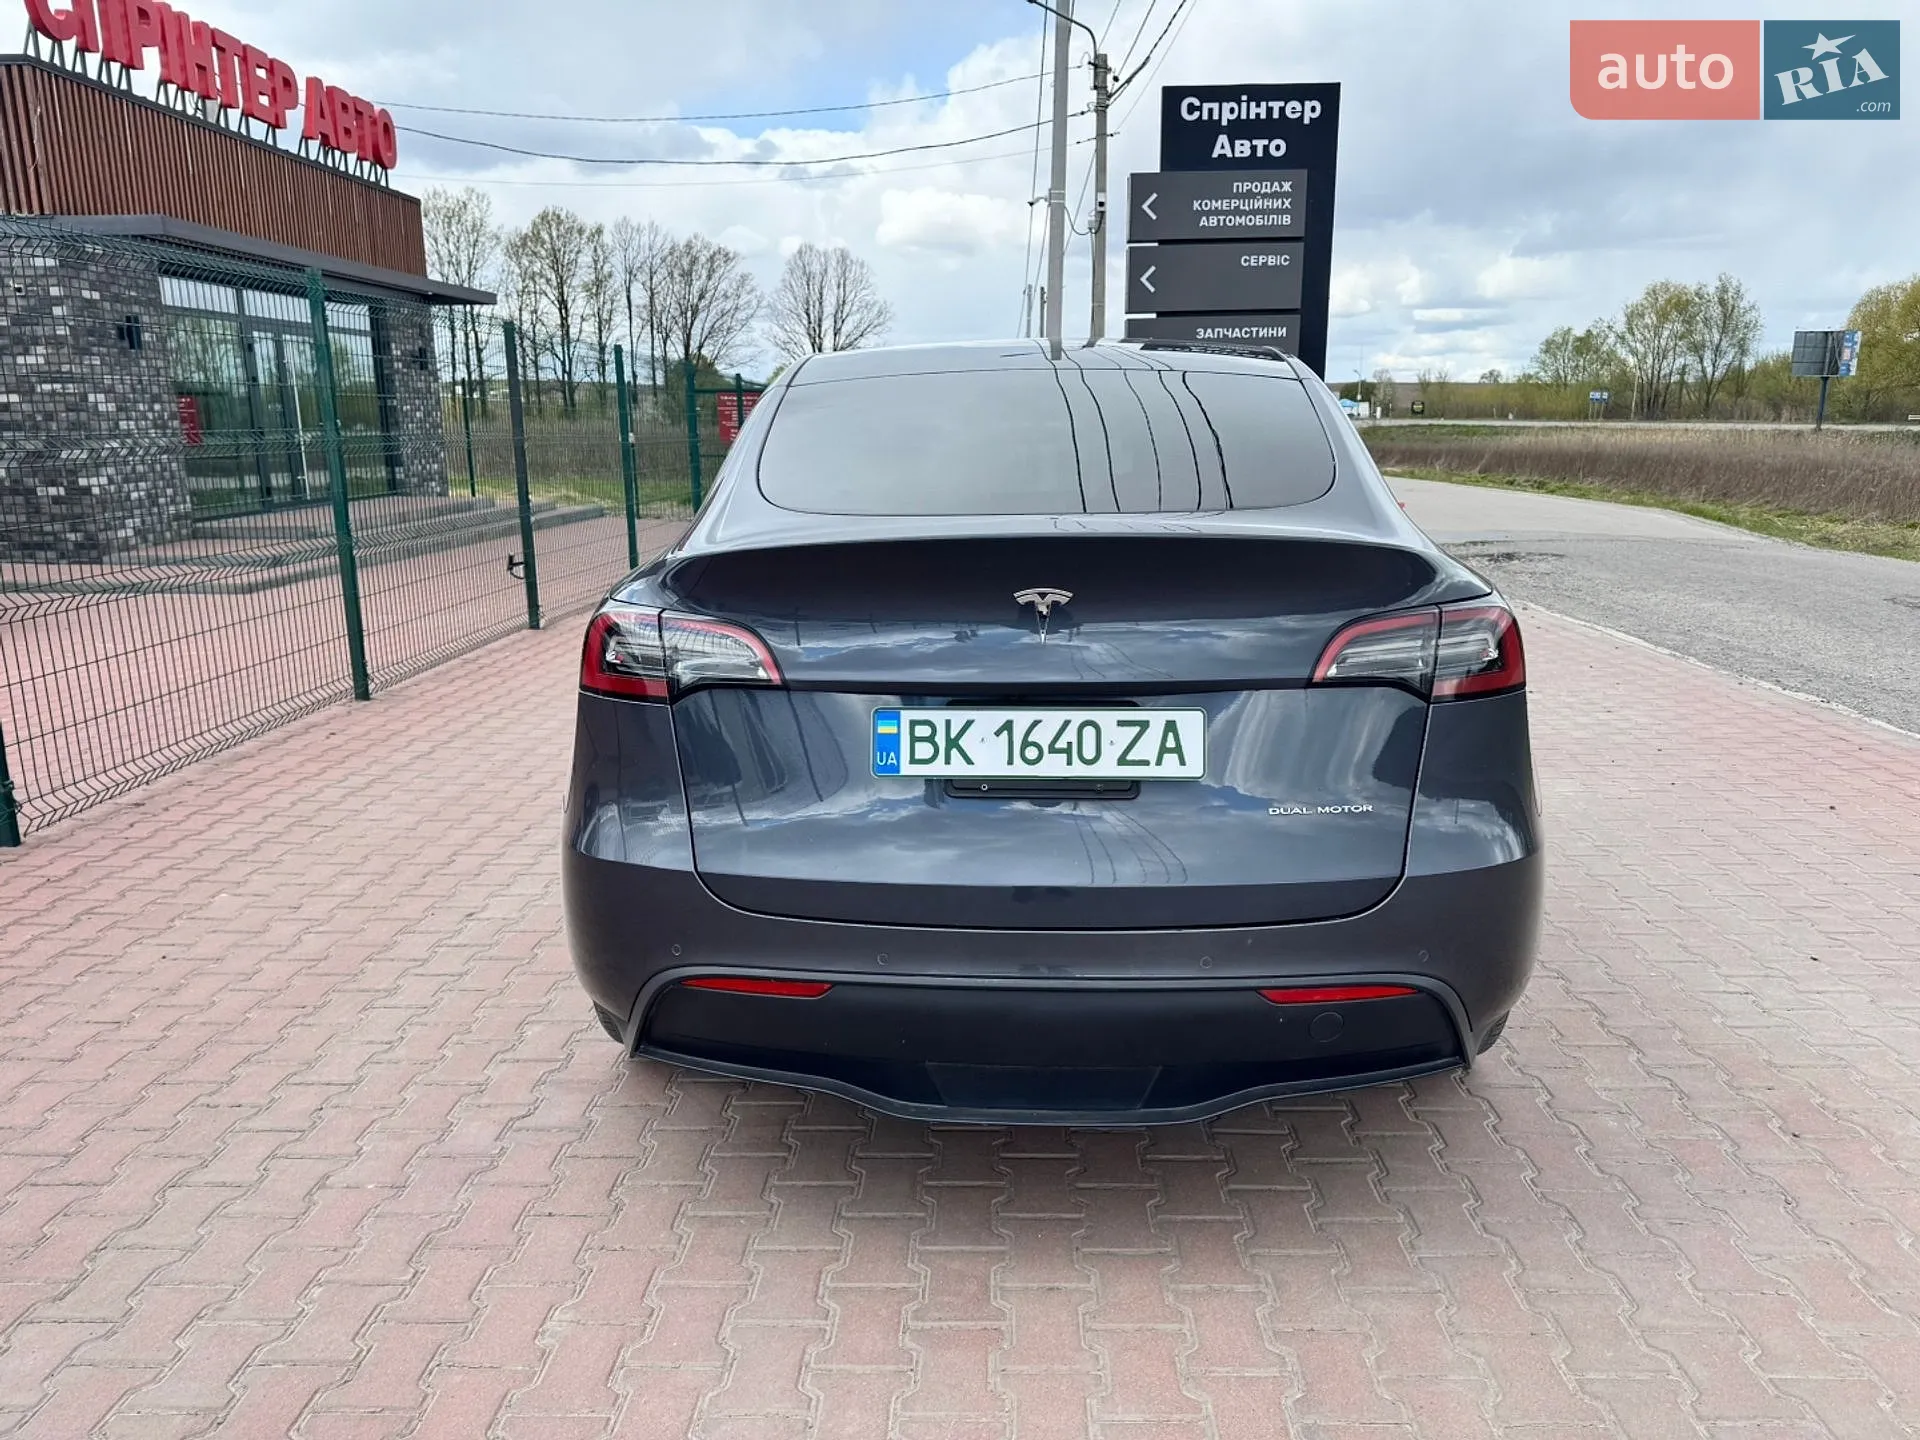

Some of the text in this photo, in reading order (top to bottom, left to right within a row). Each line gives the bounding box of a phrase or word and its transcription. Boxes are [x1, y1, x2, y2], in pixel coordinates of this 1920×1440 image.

[1180, 95, 1322, 126] Спрінтер
[303, 76, 397, 170] АВТО
[1211, 134, 1287, 158] Авто
[1233, 181, 1292, 194] ПРОДАЖ
[1193, 195, 1292, 212] КОМЕРЦІЙНИХ
[1199, 214, 1291, 227] АВТОМОБІЛІВ
[1241, 254, 1290, 266] СЕРВІС
[1196, 326, 1287, 339] ЗАПЧАСТИНИ
[908, 719, 1187, 767] BK 1640 ZA
[877, 752, 897, 766] UA
[1268, 804, 1374, 815] DUAL MOTOR
